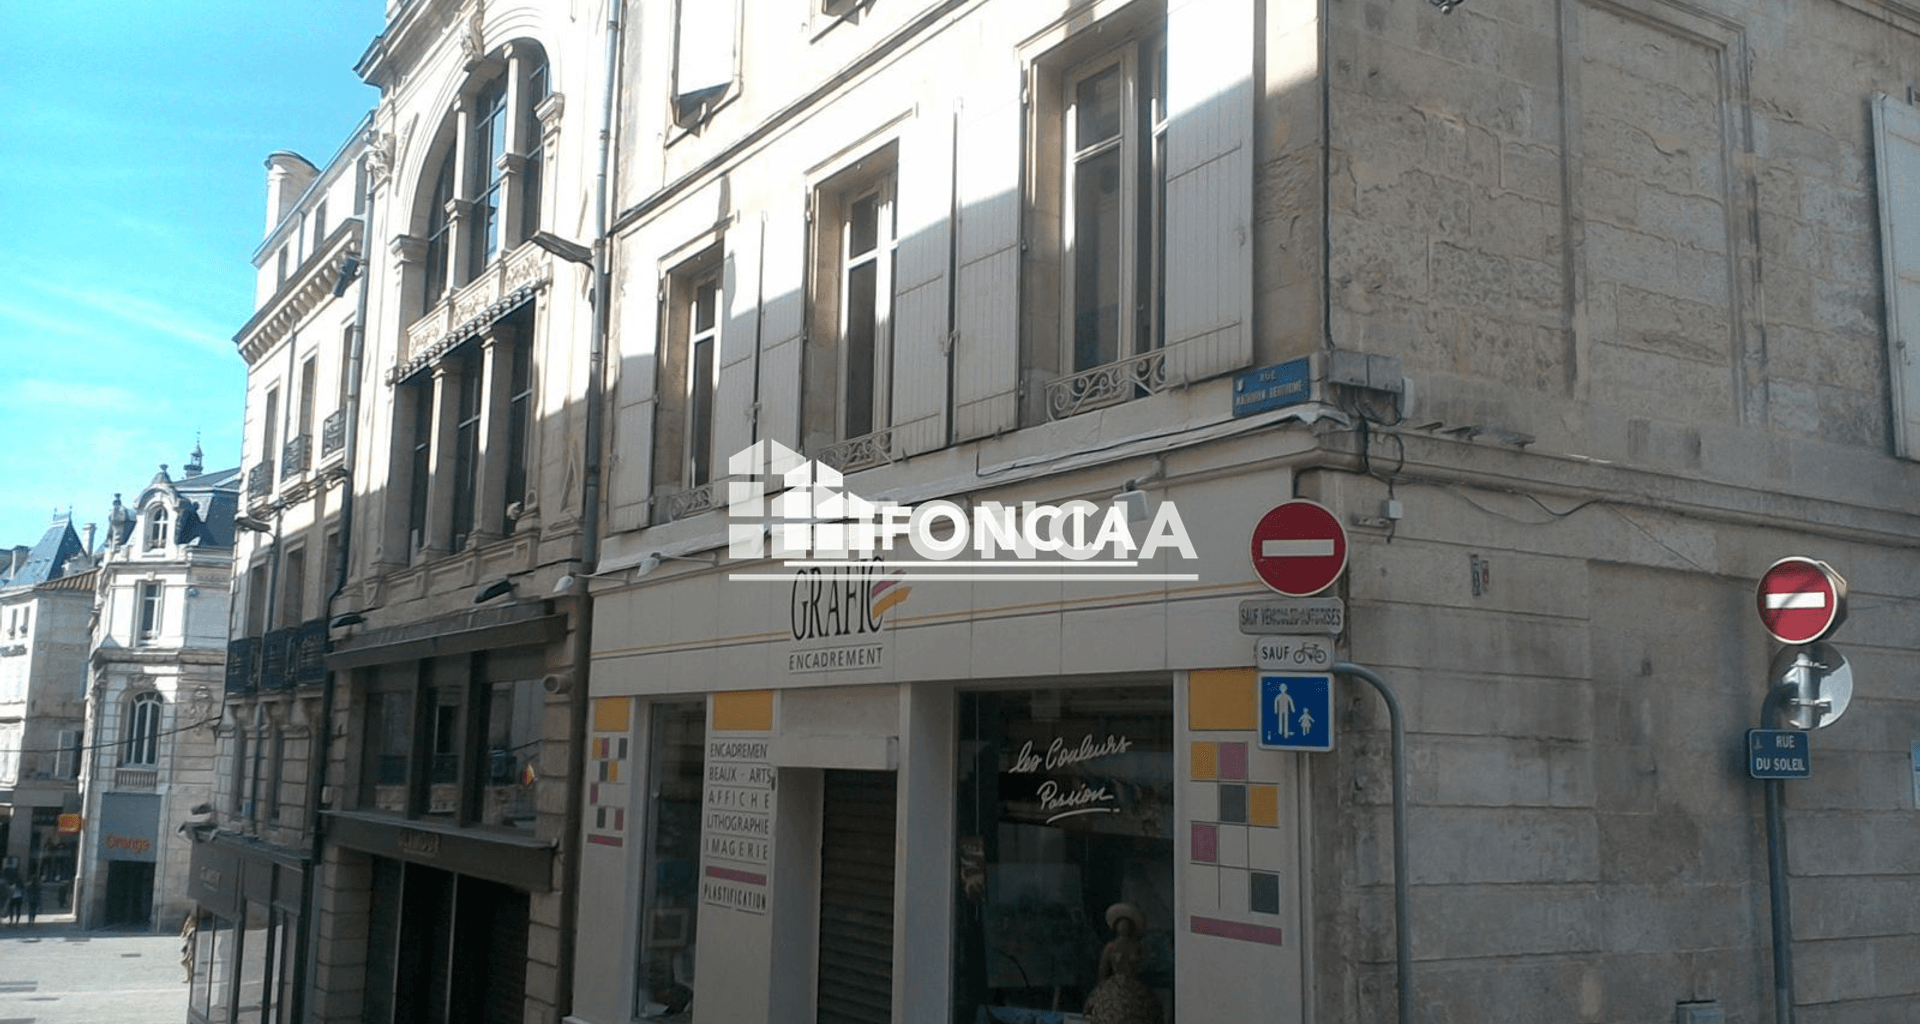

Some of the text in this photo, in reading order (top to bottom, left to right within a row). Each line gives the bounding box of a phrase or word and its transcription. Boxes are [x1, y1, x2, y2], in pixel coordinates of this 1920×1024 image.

[1260, 369, 1277, 382] RUE
[790, 556, 885, 641] GRAFIC
[1241, 607, 1259, 626] SAUF
[788, 646, 883, 671] ENCADREMENT
[1262, 646, 1290, 661] SAUF
[710, 742, 769, 759] ENCADREMEN
[1775, 734, 1796, 749] RUE
[1755, 757, 1806, 771] DU SOLEIL
[708, 766, 737, 782] BEAUX
[748, 767, 773, 785] ARTS
[708, 789, 770, 810] AFFICHE
[1036, 780, 1115, 810] Passion
[706, 813, 769, 836] LITHOGRAPHIE
[705, 838, 768, 861] IMAGERIE
[703, 883, 766, 911] PLASTIFICATION
